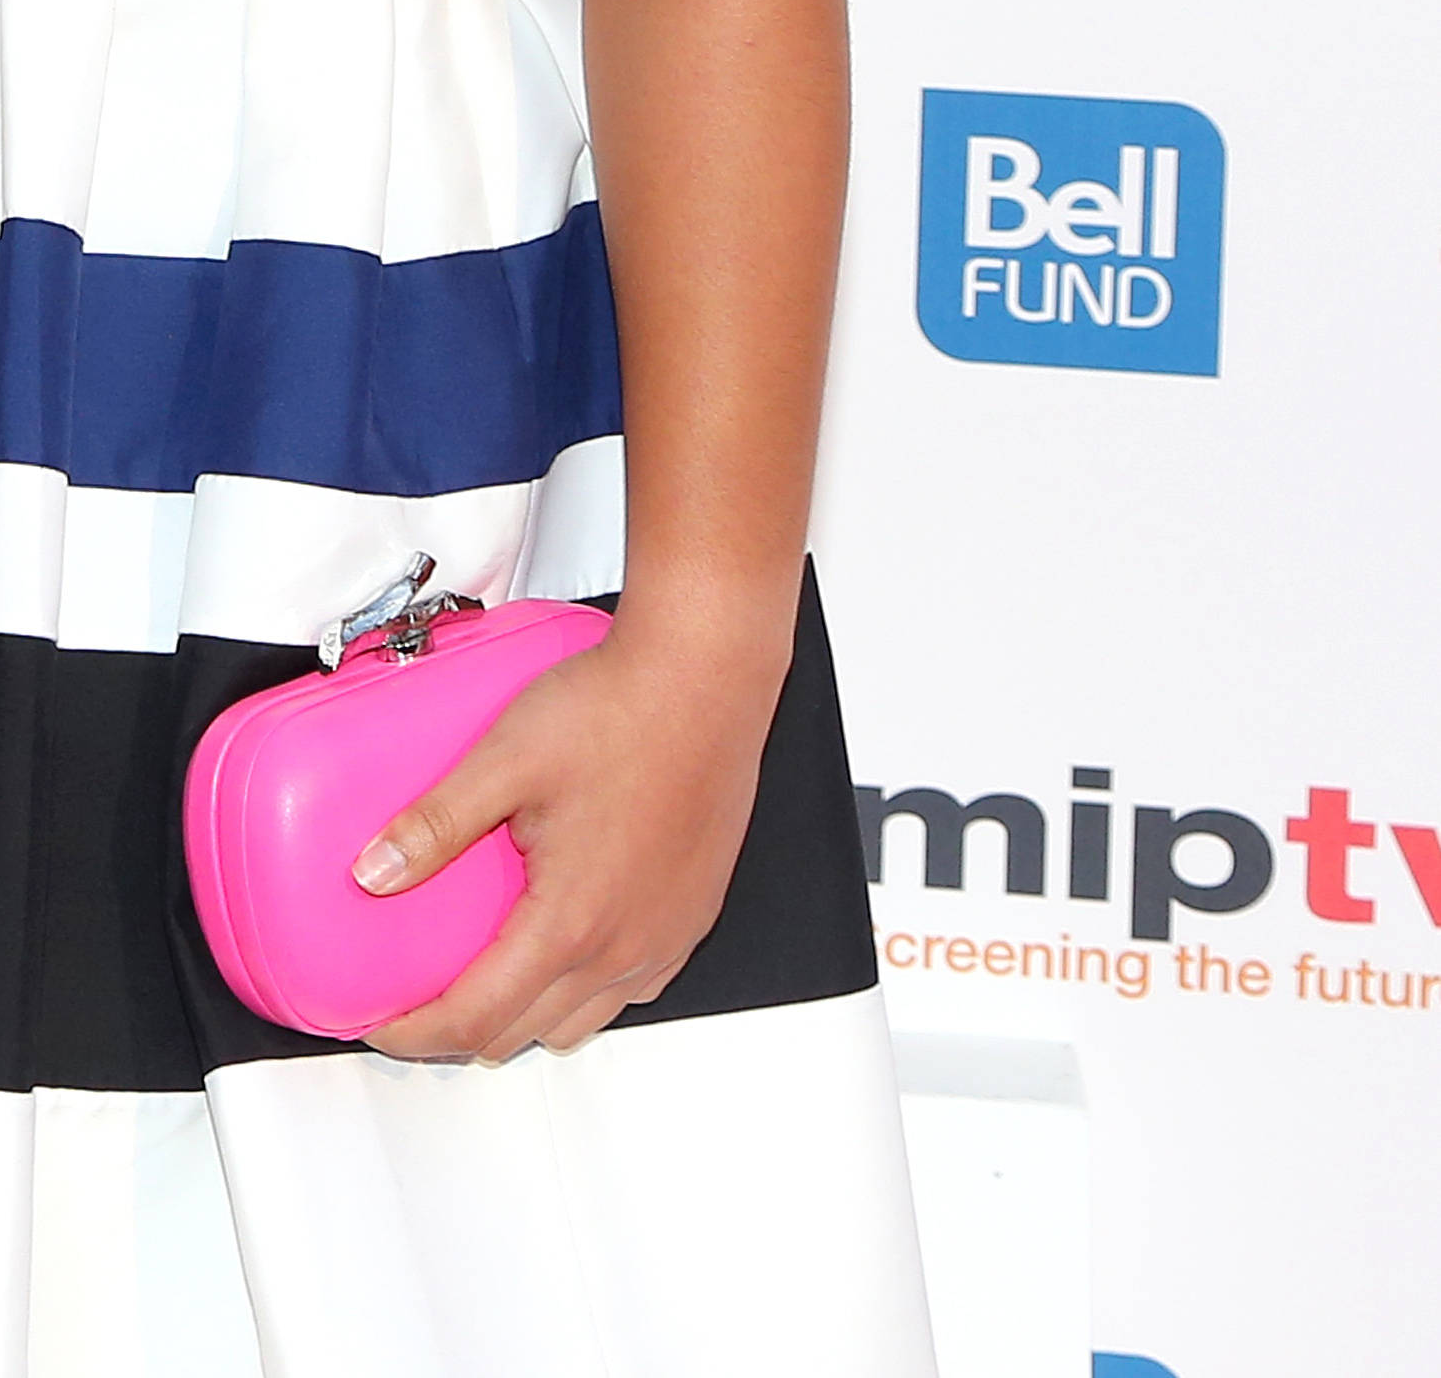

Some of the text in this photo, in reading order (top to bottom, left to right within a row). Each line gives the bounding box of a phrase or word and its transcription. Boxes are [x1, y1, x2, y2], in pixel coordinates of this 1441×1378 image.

[964, 136, 1179, 259] Bell
[962, 258, 1175, 328] FUND
[872, 924, 1441, 1009] creening the futur
